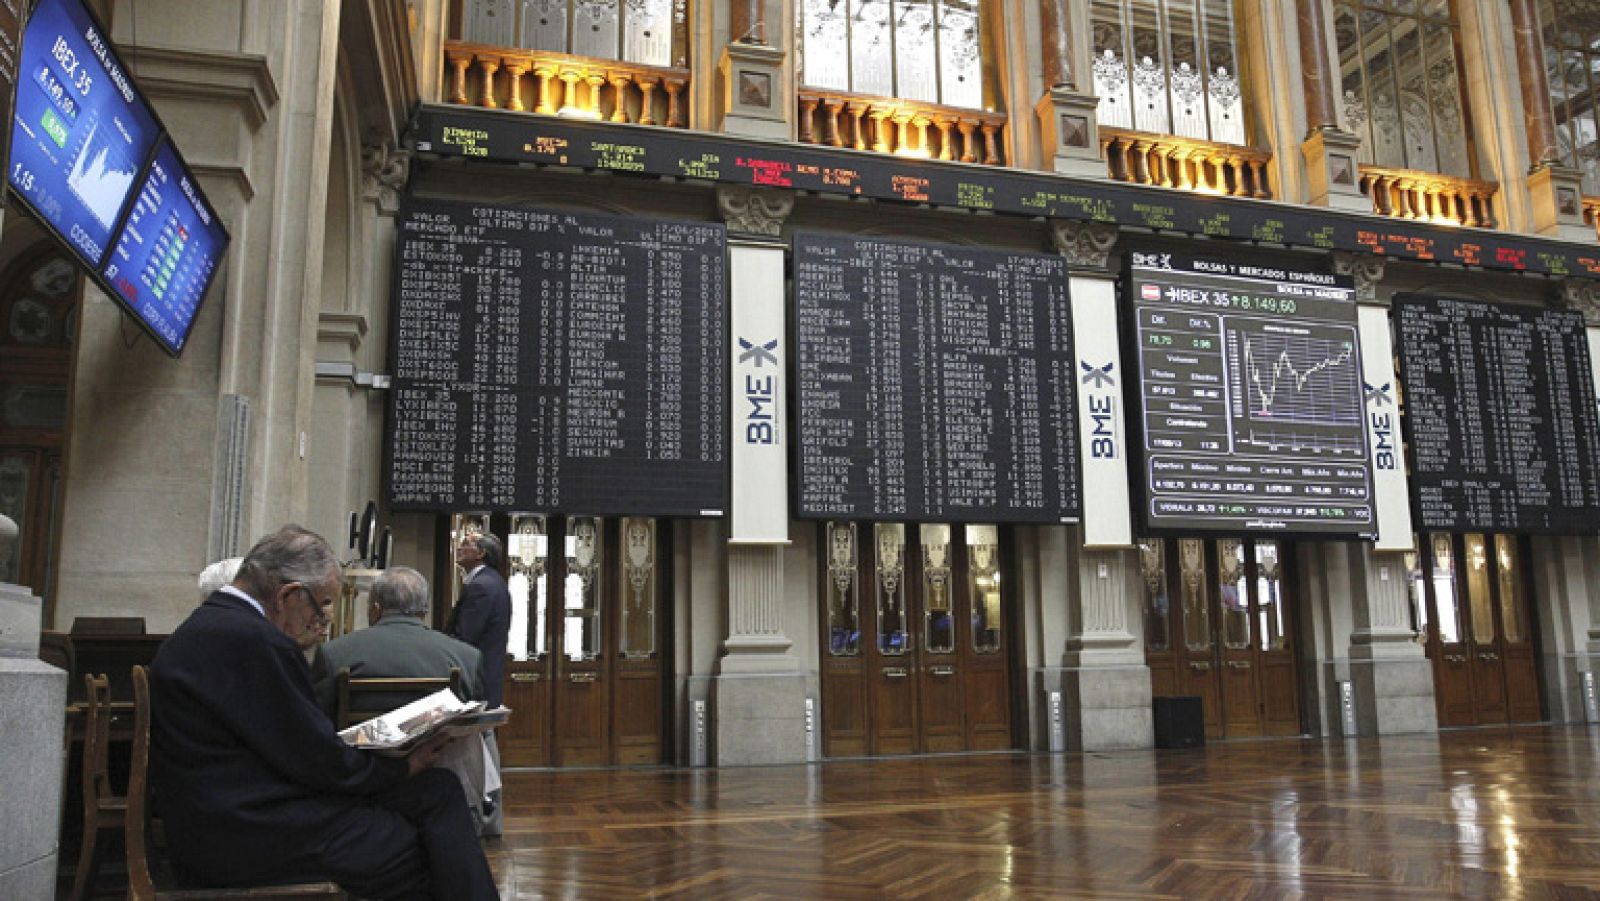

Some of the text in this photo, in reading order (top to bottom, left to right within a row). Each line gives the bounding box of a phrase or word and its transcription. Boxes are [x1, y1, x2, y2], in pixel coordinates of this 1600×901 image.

[52, 35, 92, 96] IBEX 35
[412, 212, 450, 222] VALOR
[479, 218, 522, 230] ULTIMO
[472, 208, 558, 223] COTIZACIONES
[578, 226, 613, 237] VALOR
[405, 241, 433, 250] IBEX
[1193, 261, 1226, 273] BOLSAS
[1230, 265, 1236, 273] Y
[1240, 266, 1285, 280] MERCADOS
[1172, 292, 1296, 313] IBEX 35 8.149,60
[746, 375, 772, 444] BME
[1089, 394, 1113, 459] BME
[1371, 412, 1394, 470] BME
